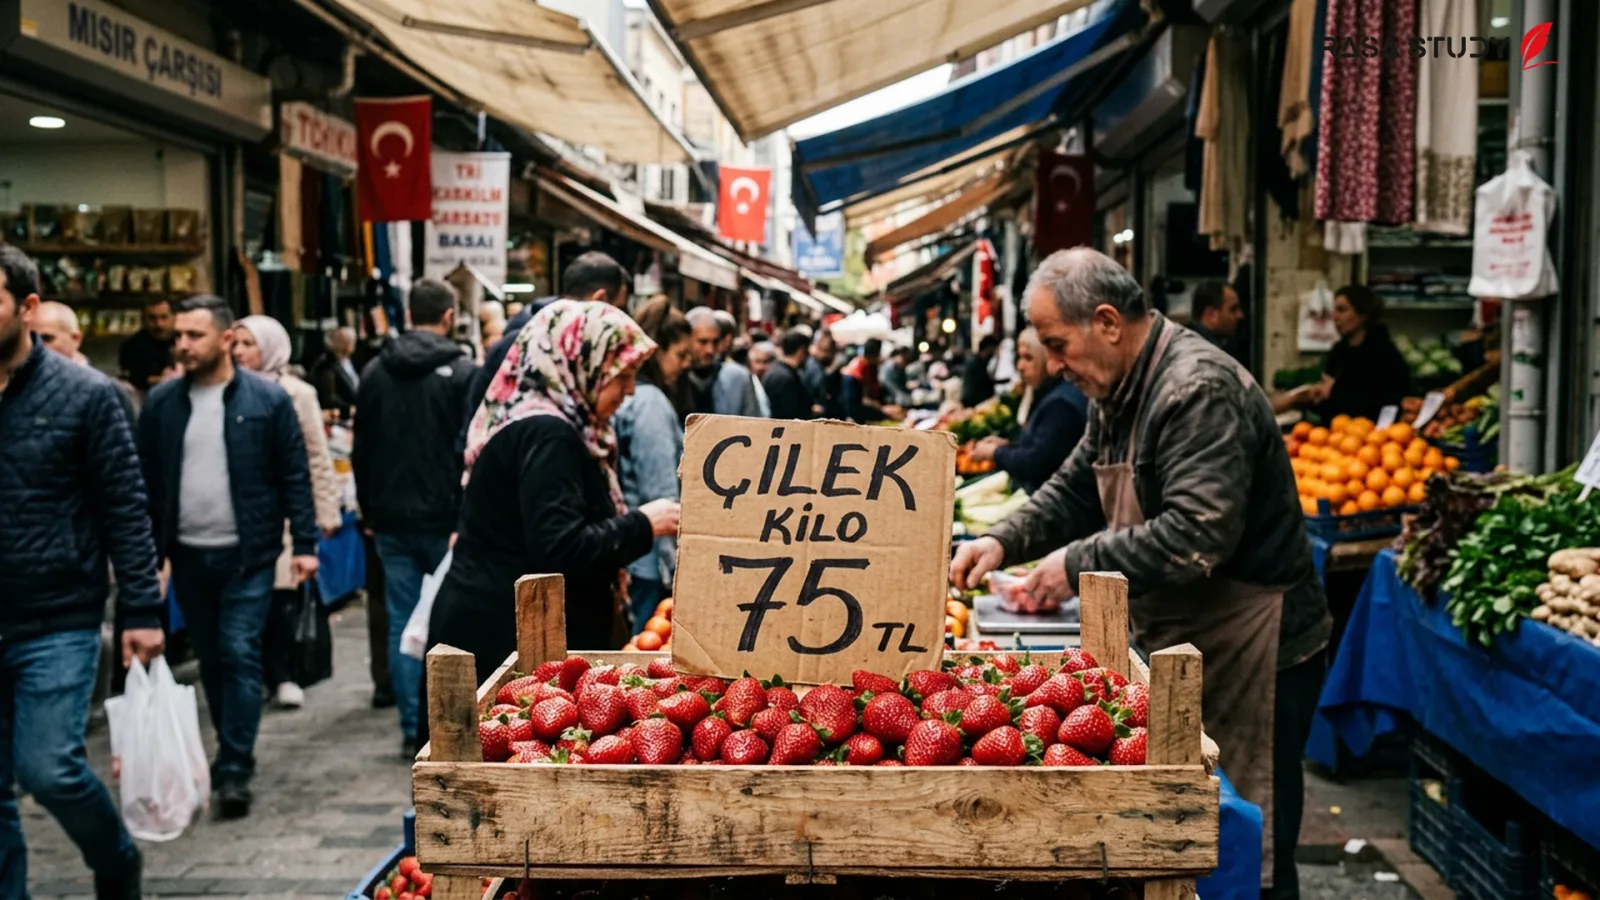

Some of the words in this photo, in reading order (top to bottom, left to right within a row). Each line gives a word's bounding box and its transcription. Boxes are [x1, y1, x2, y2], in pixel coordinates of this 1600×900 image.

[68, 3, 137, 65] MISIR
[144, 36, 222, 98] ÇARŞISI
[702, 427, 919, 511] ÇİLEK
[760, 502, 868, 545] KİLO
[719, 554, 871, 655] 75
[872, 622, 928, 653] TL
